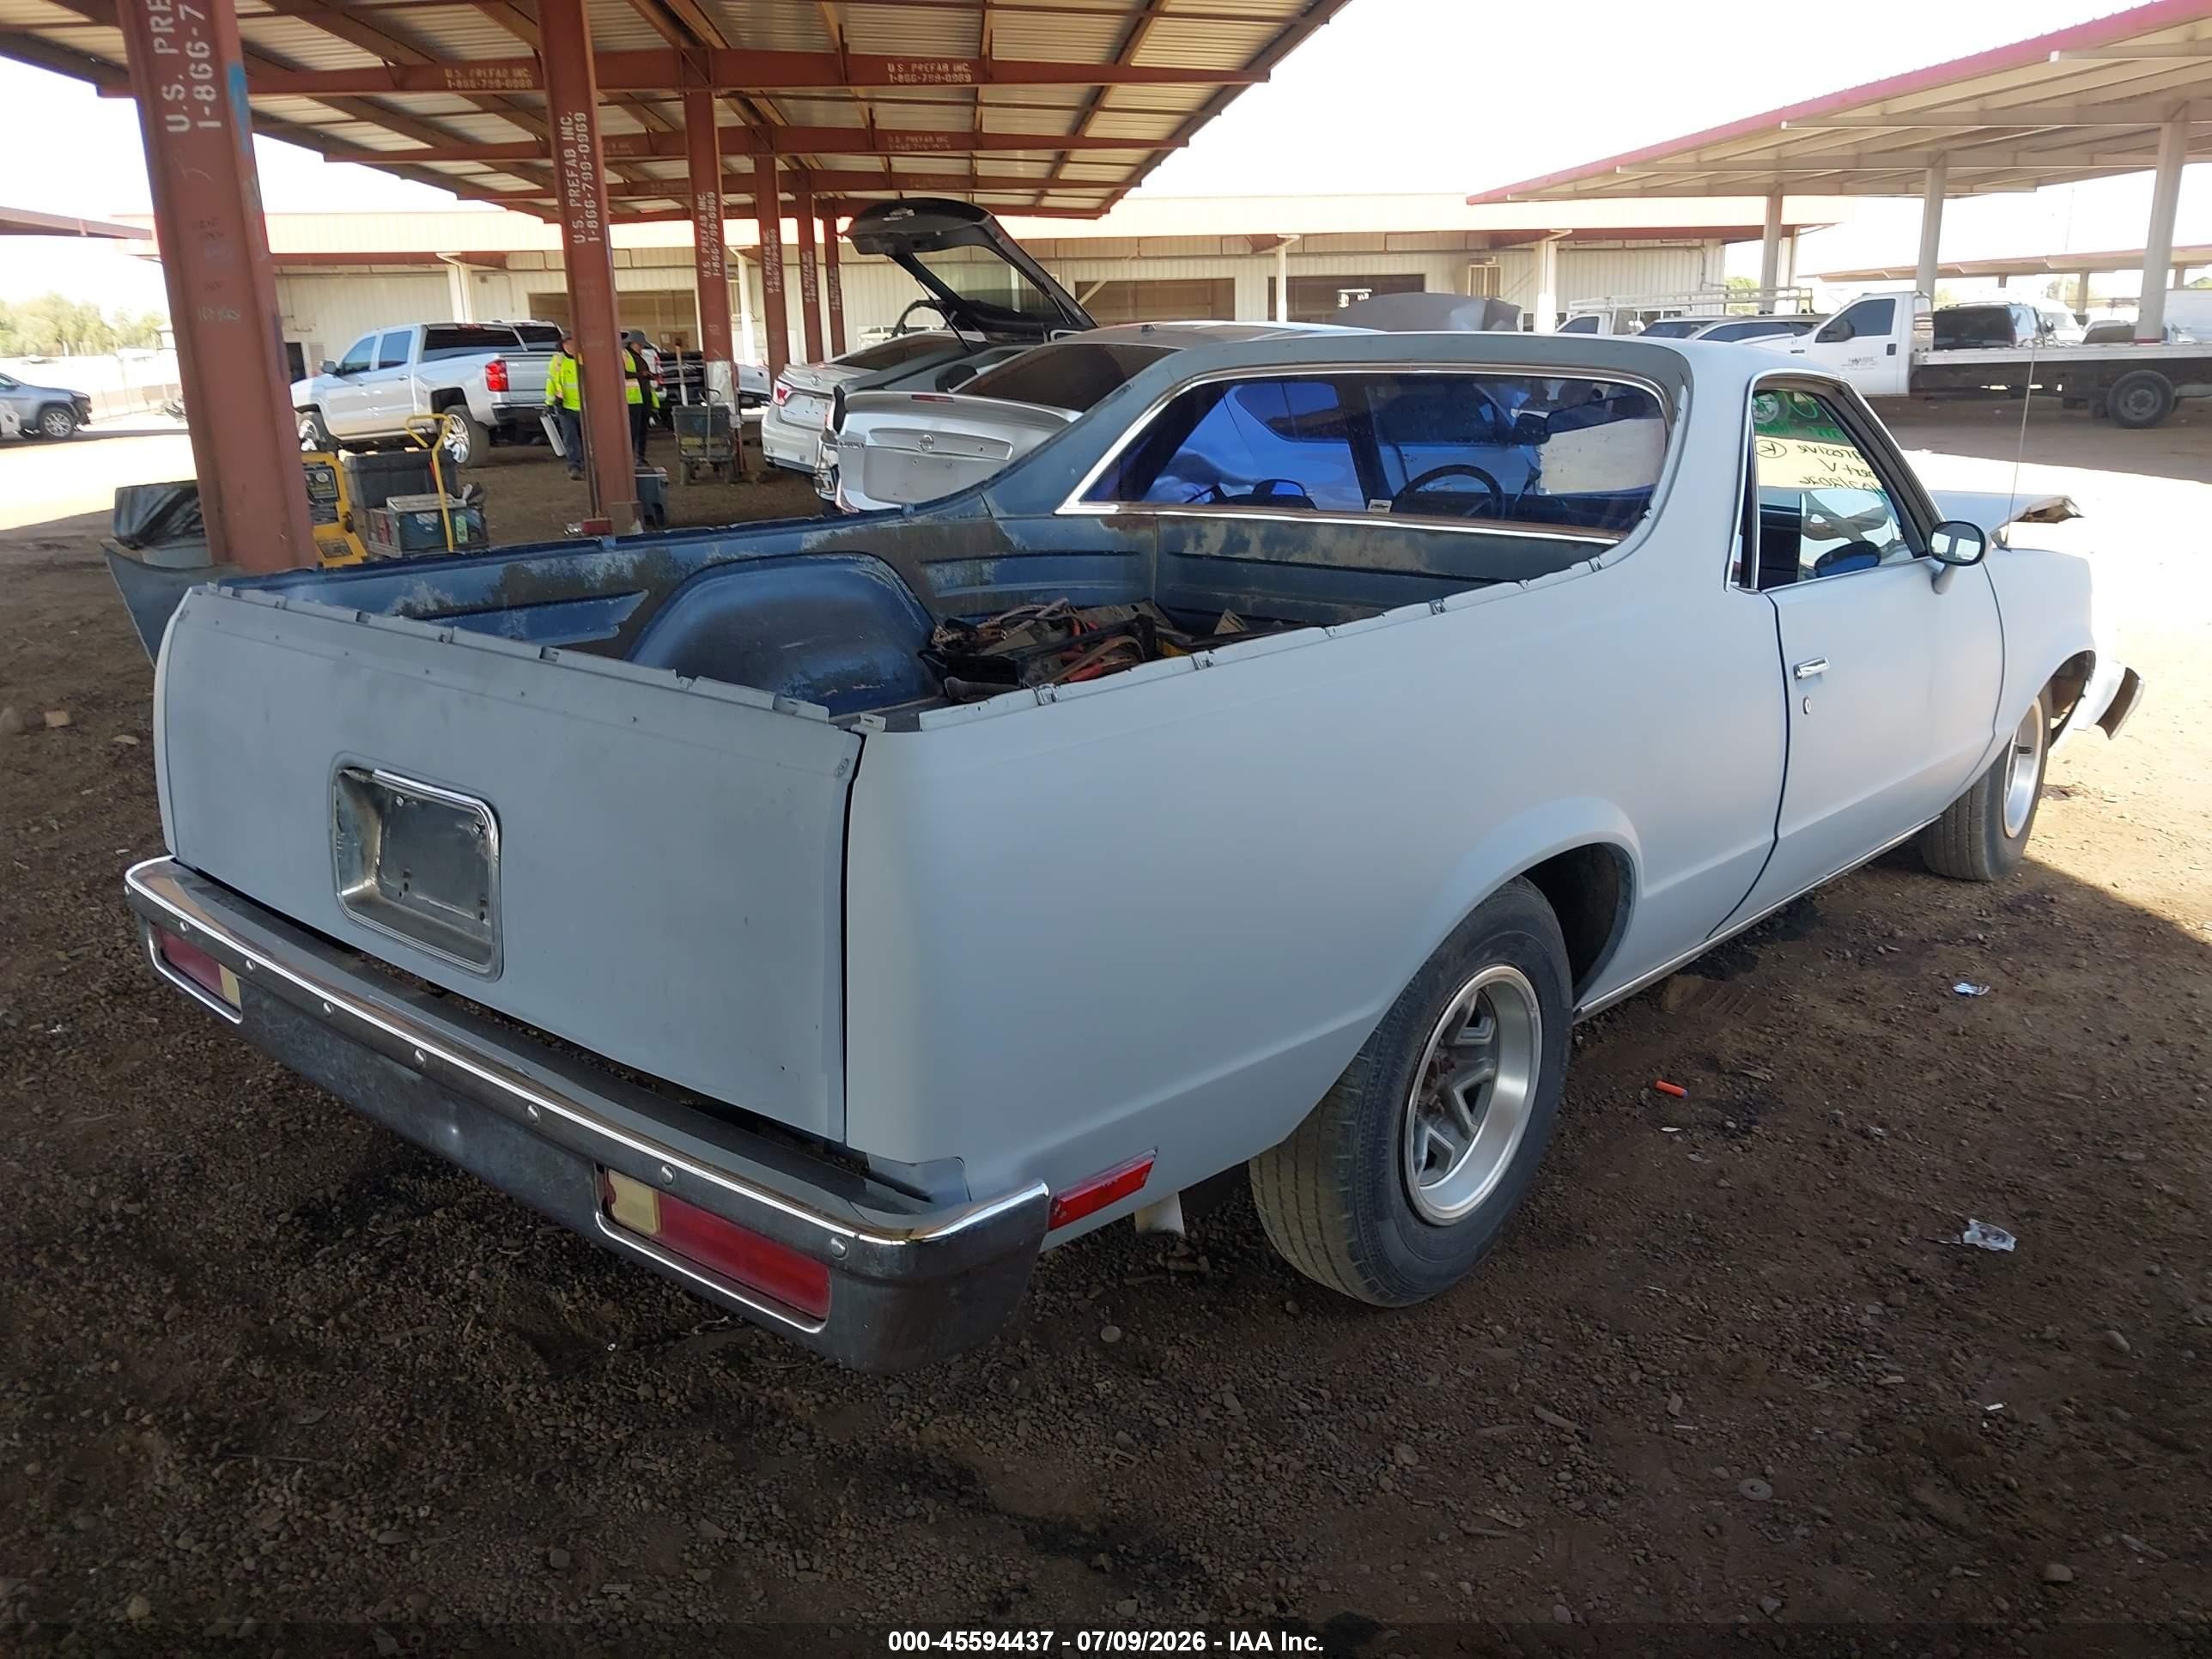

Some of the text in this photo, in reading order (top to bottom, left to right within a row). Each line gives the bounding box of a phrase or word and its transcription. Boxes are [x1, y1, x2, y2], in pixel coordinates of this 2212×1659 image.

[161, 74, 191, 132] U.S.
[178, 3, 222, 128] 1-866-7
[560, 111, 587, 245] U.S. PREFAB INC.
[574, 112, 601, 244] 1-866-799-0969
